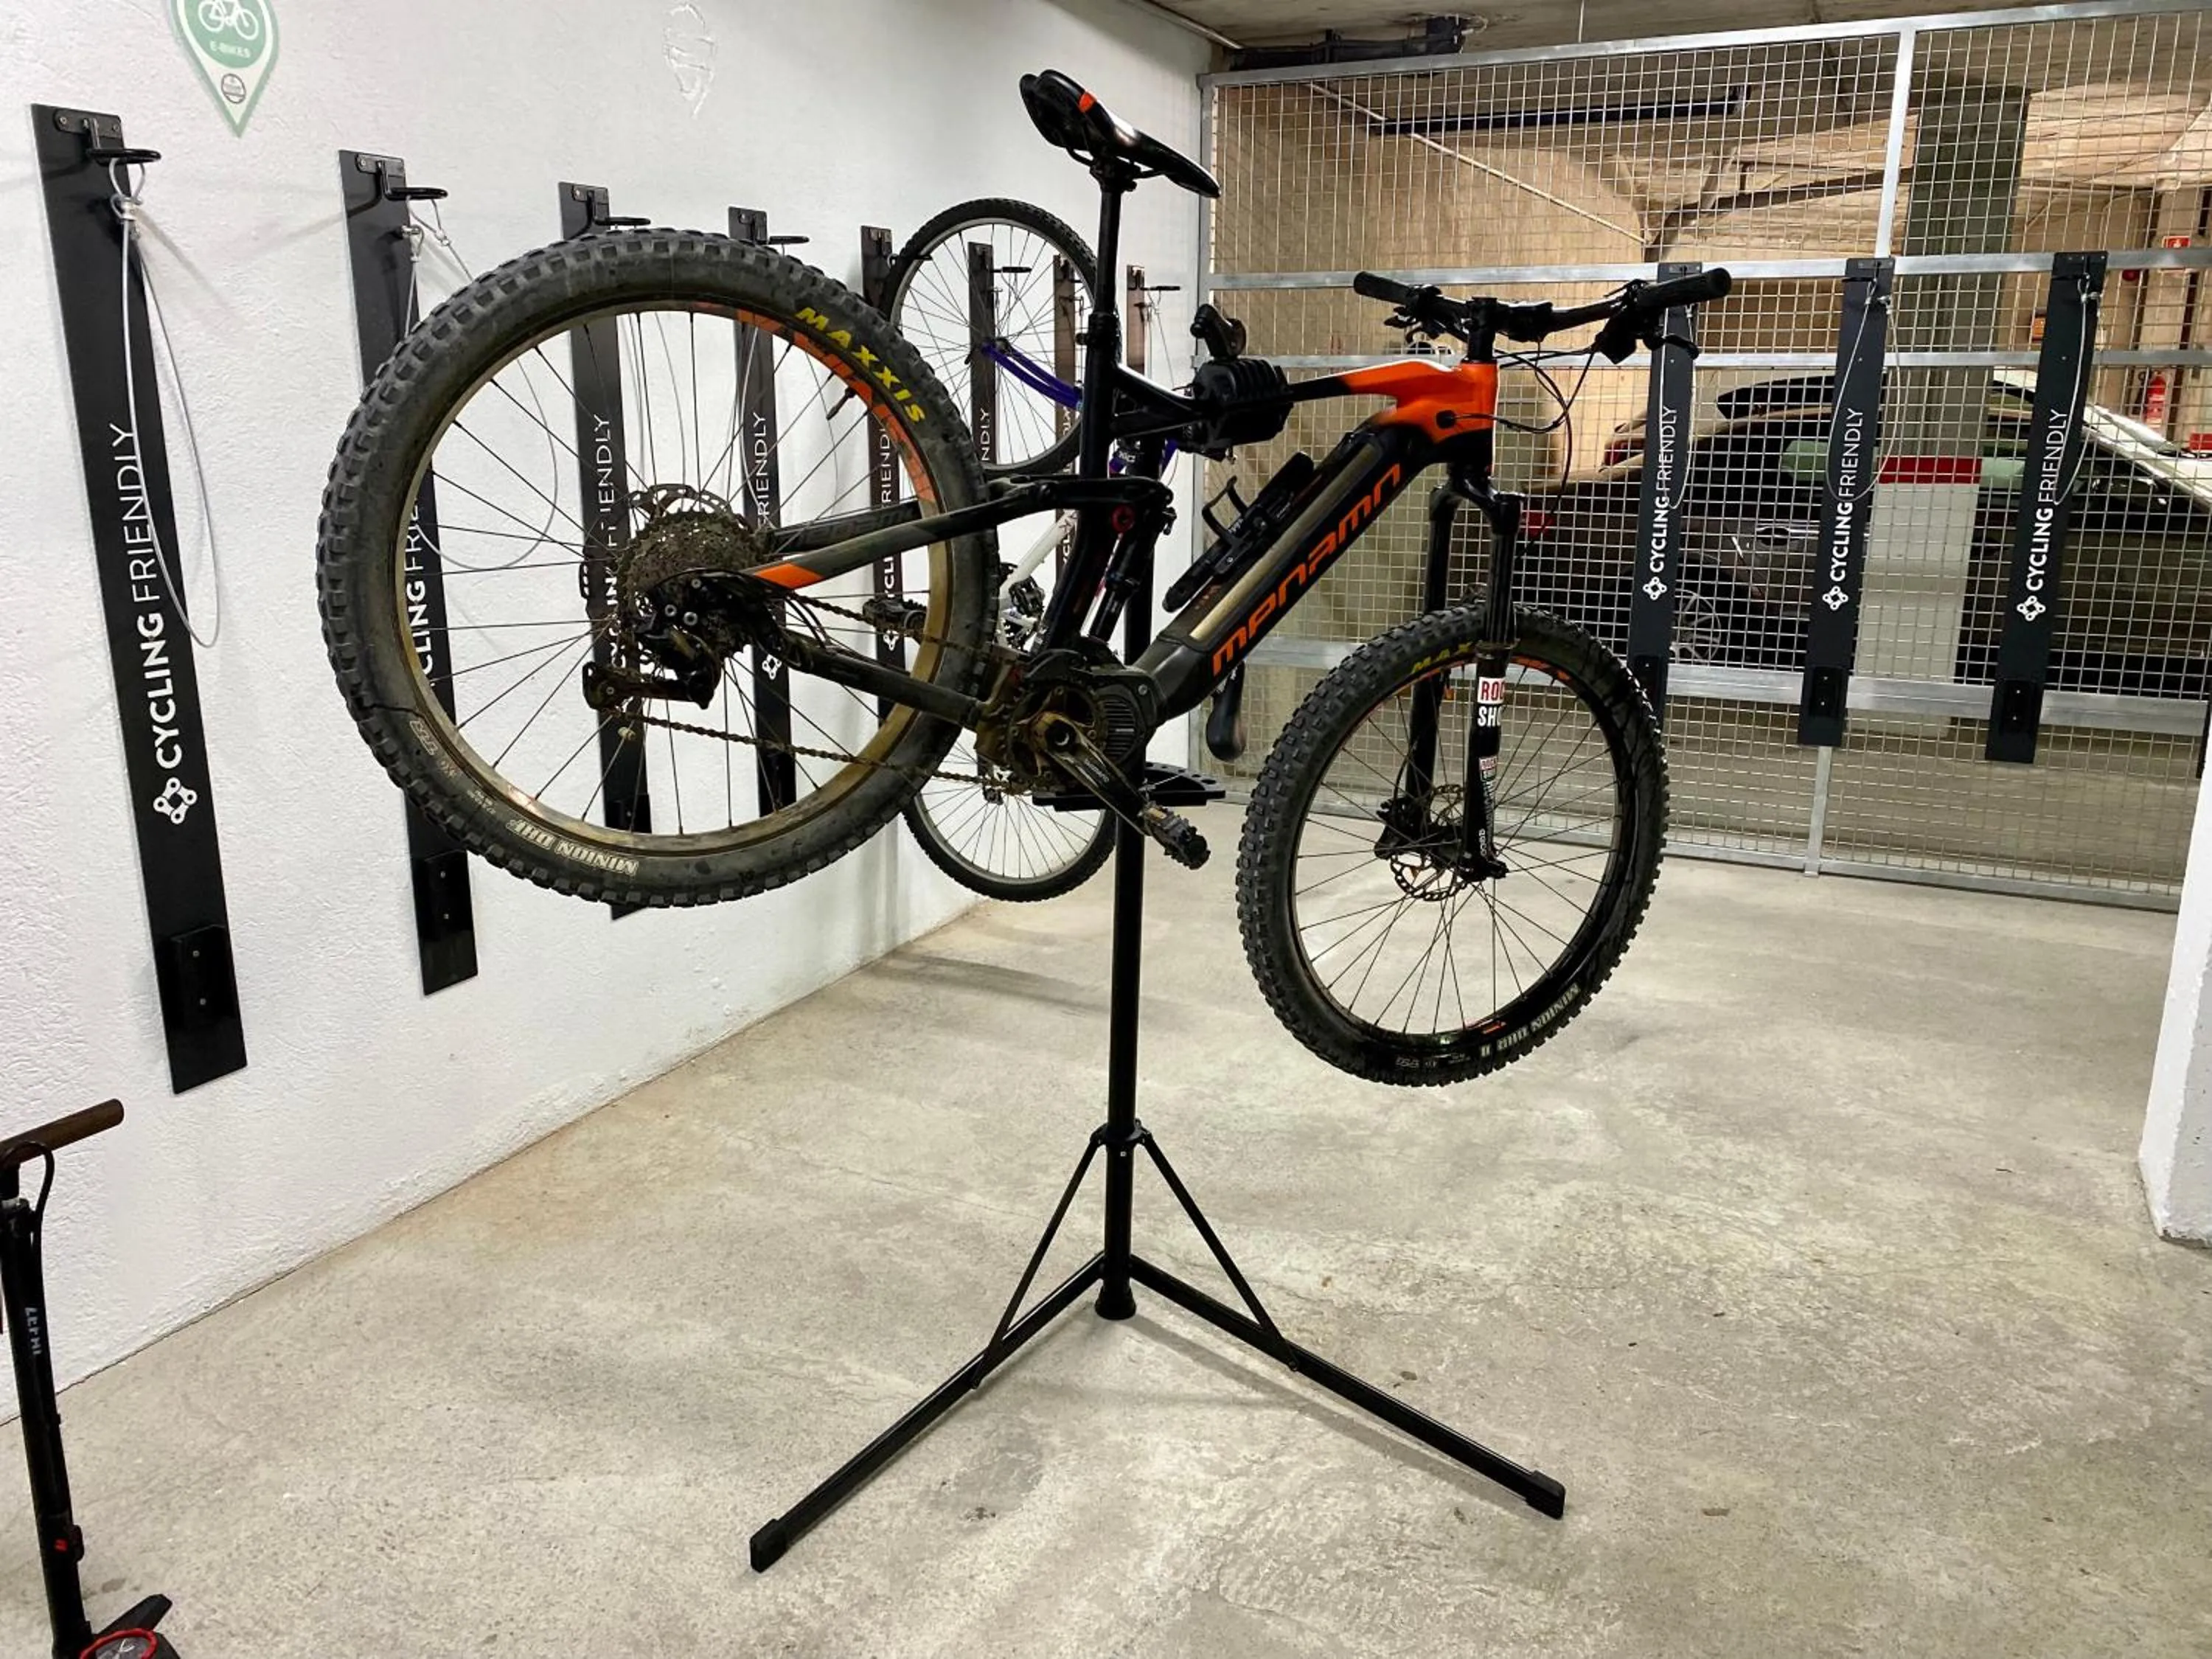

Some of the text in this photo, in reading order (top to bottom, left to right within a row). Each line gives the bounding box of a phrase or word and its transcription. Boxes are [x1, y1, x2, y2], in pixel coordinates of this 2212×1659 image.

[796, 307, 926, 423] MAXXIS
[1649, 406, 1678, 572] CYCLING FRIENDLY
[1830, 408, 1864, 582] CYCLING FRIENDLY
[2025, 408, 2068, 591] CYCLING FRIENDLY
[108, 423, 183, 769] CYCLING FRIENDLY
[554, 839, 639, 877] MINION
